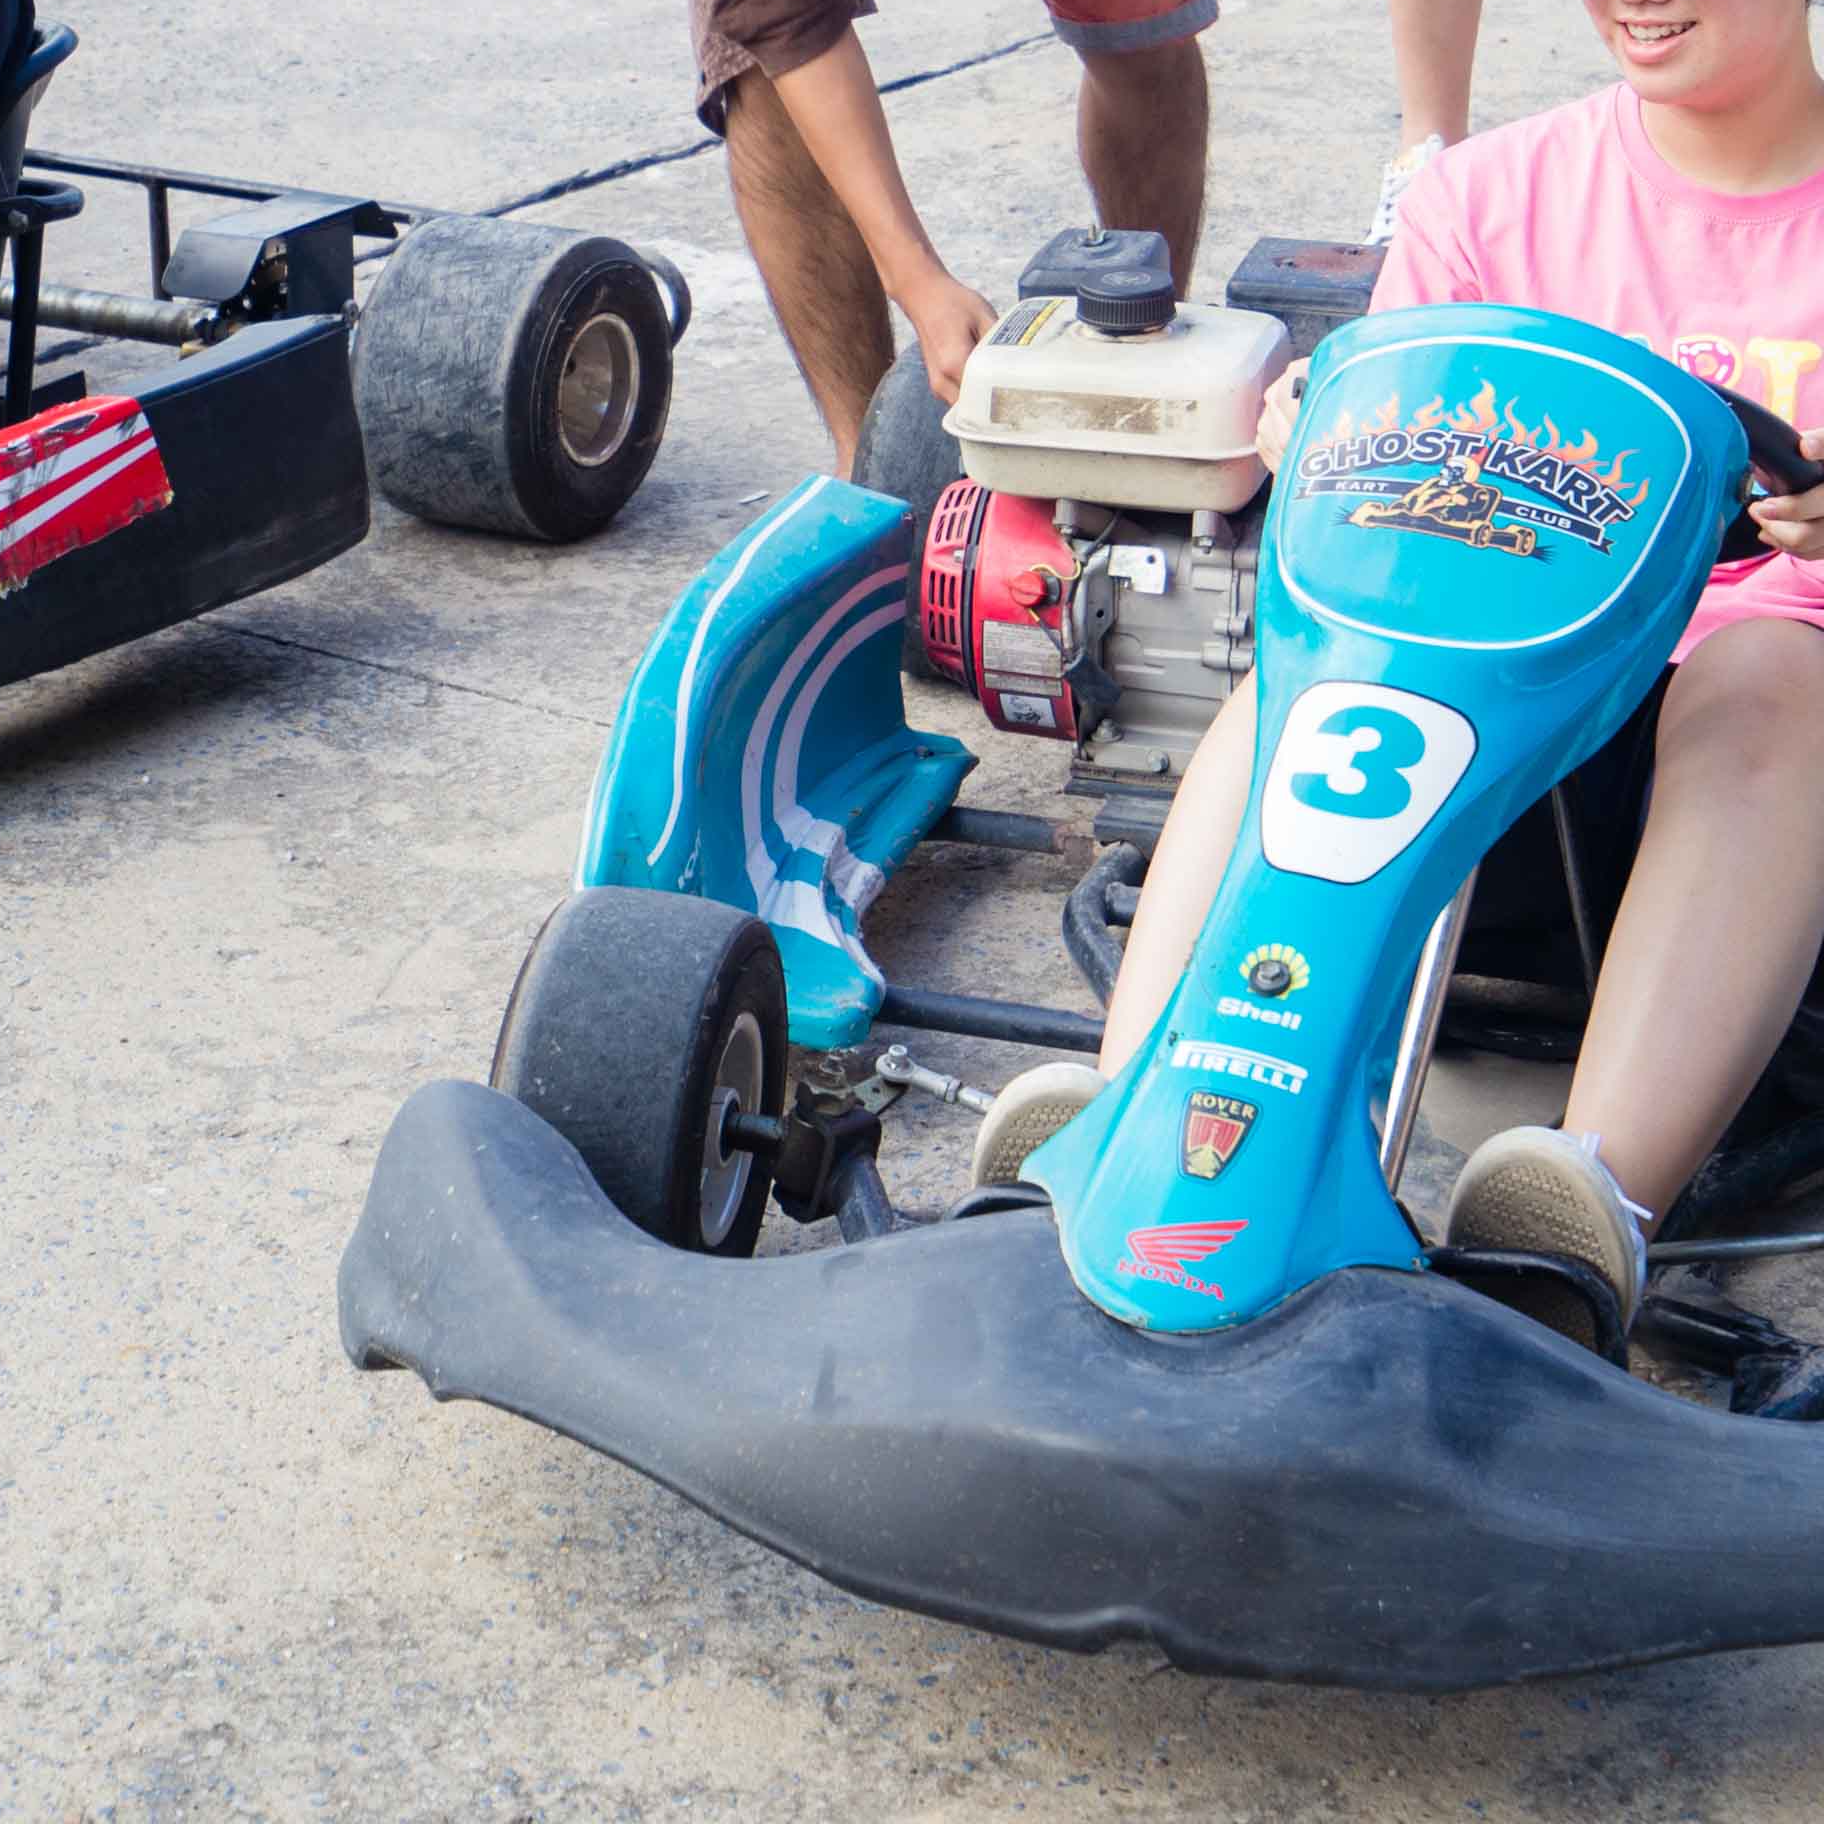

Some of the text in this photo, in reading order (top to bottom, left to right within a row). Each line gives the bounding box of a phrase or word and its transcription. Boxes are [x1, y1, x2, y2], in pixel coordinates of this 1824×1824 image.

[1299, 430, 1634, 525] GHOST KART
[1335, 480, 1573, 530] KART CLUB
[1290, 705, 1426, 819] 3
[1217, 996, 1303, 1030] Shell
[1170, 1039, 1309, 1095] PIRELLI
[1191, 1092, 1256, 1119] ROVER
[1117, 1257, 1225, 1301] HONDA
